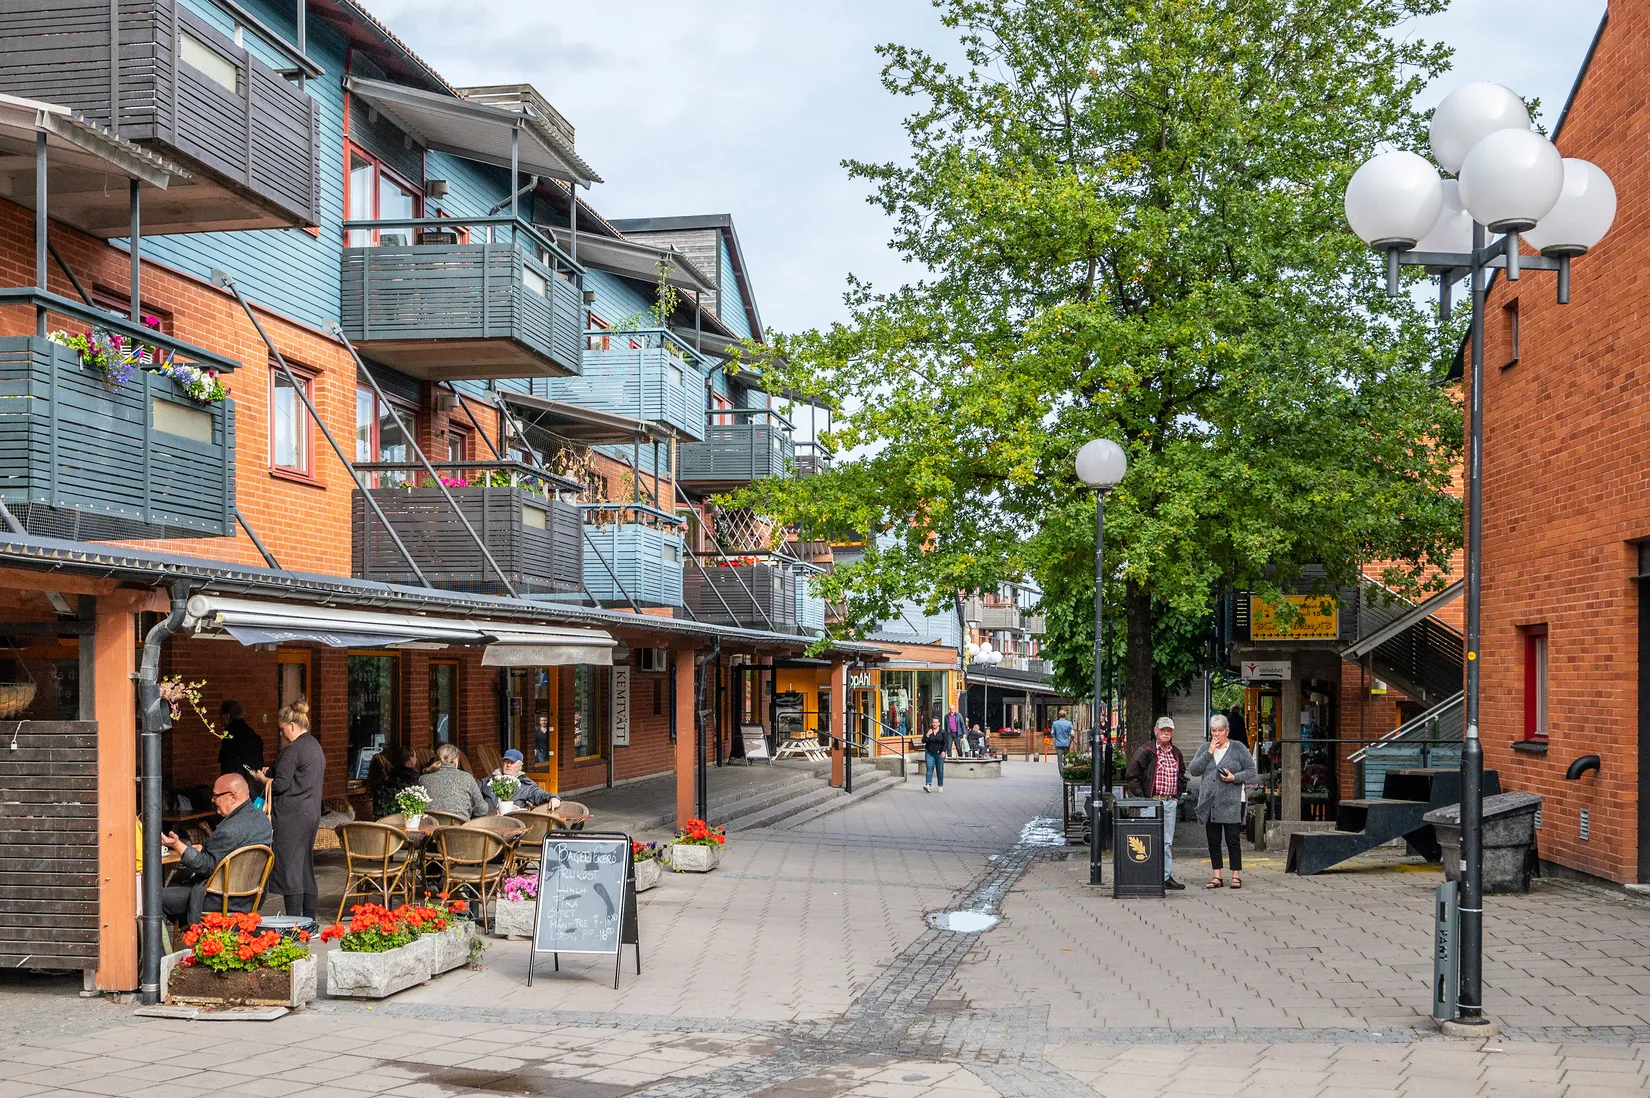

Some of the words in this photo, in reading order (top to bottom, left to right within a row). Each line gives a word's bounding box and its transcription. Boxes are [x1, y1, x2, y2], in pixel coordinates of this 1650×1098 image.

[616, 671, 626, 741] KEMTVÄTT
[552, 865, 599, 880] FRUKOST
[556, 880, 588, 894] LUNCH
[547, 906, 576, 918] ÖPPET
[1439, 930, 1448, 961] PANT
